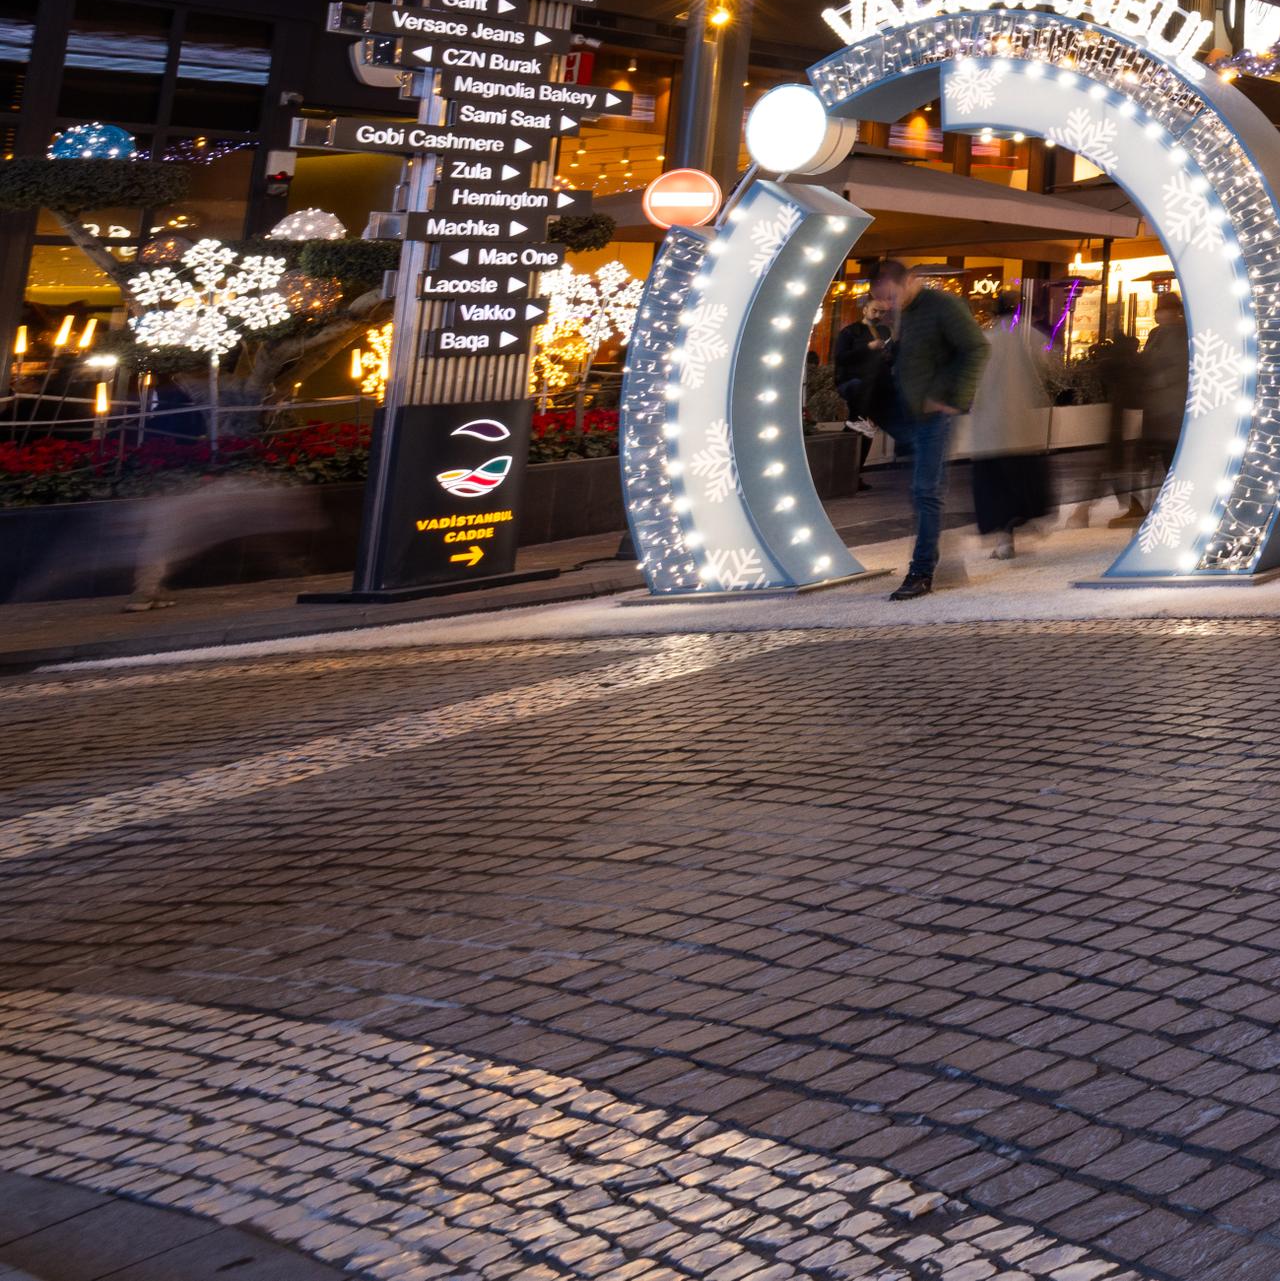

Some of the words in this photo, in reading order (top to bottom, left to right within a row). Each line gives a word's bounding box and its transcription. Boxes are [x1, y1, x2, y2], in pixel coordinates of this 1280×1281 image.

[392, 10, 468, 36] Versace
[472, 23, 525, 44] Jeans
[442, 48, 486, 69] CZN
[489, 53, 541, 74] Burak
[454, 76, 535, 100] Magnolia
[539, 81, 597, 109] Bakery
[460, 105, 507, 126] Sami
[511, 110, 551, 130] Saat
[356, 125, 404, 146] Gobi
[409, 130, 504, 152] Cashmere
[450, 161, 492, 179] Zula
[452, 189, 548, 210] Hemington
[427, 218, 500, 236] Machka
[478, 249, 517, 266] Mac
[520, 249, 558, 266] One
[424, 276, 498, 293] Lacoste
[460, 304, 516, 321] Vakko
[440, 333, 489, 350] Baqa
[416, 510, 513, 531] VADİSTANBUL
[444, 527, 494, 543] CADDE
